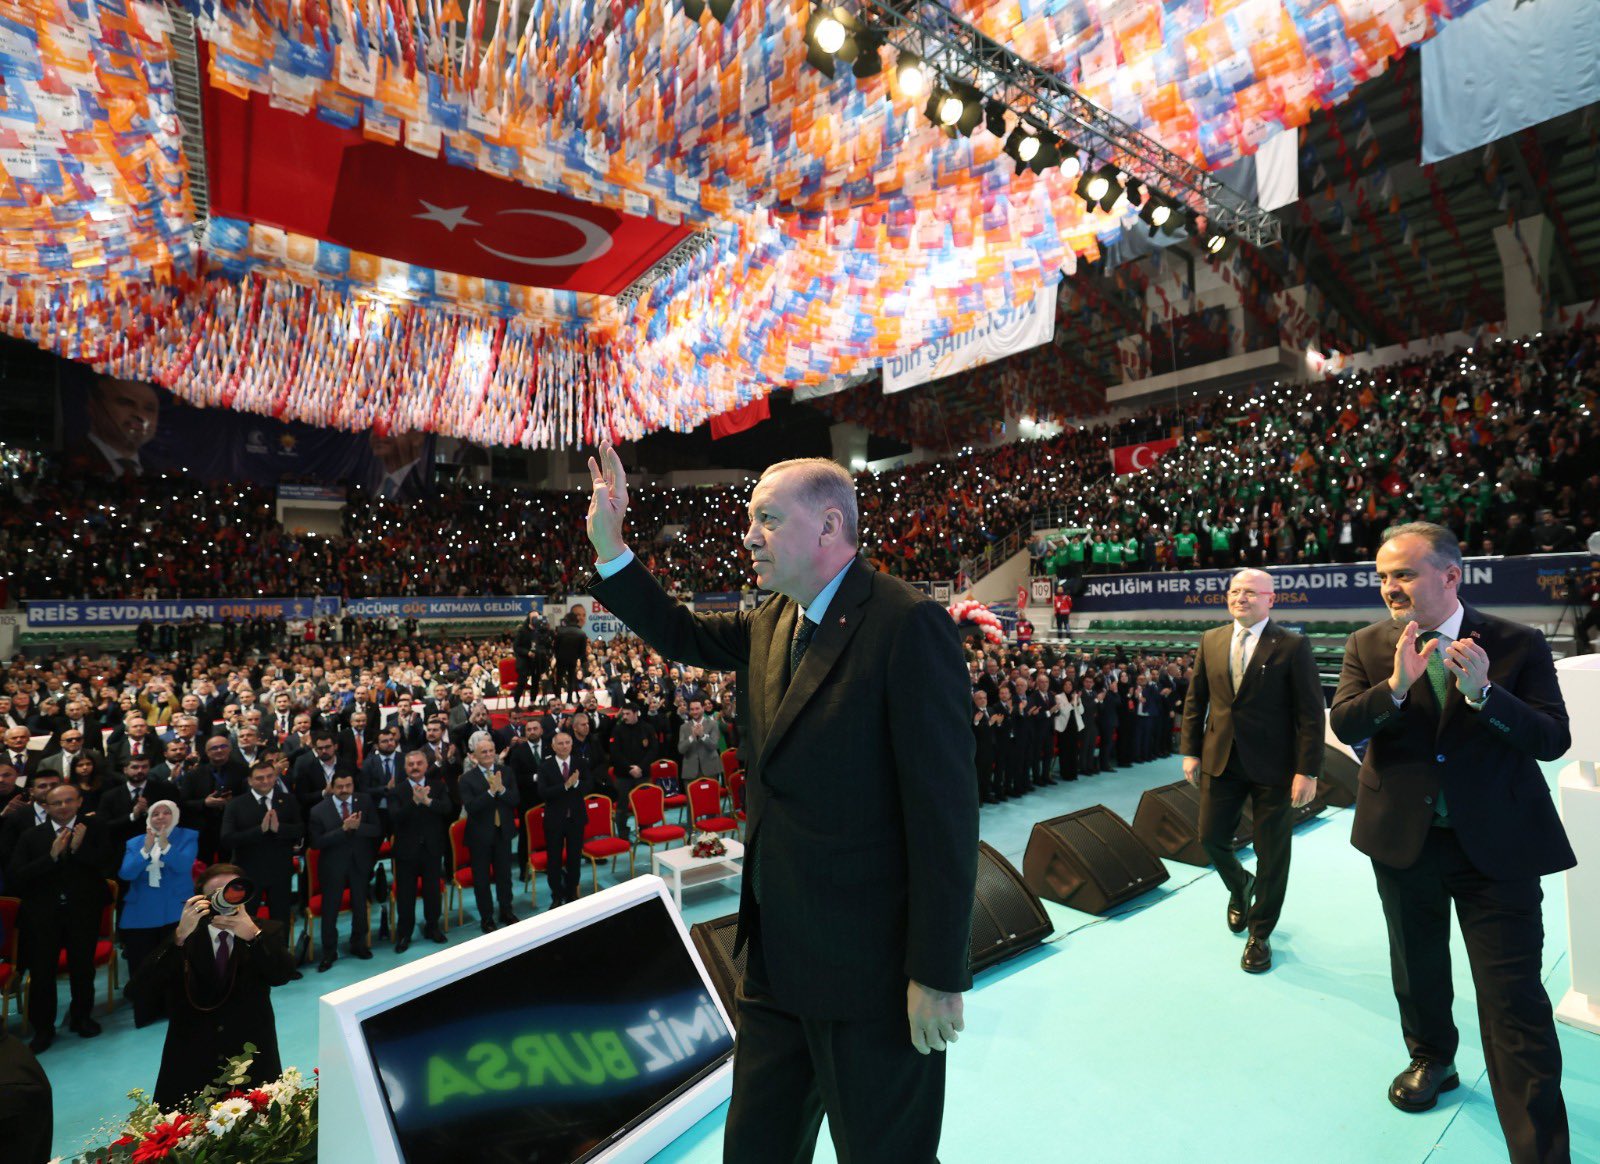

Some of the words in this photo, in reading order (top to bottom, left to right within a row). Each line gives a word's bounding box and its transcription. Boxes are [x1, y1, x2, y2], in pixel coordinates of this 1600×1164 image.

[1157, 577, 1191, 593] HER
[1195, 575, 1232, 593] ŞEY
[1274, 572, 1348, 590] EDADIR
[1354, 571, 1381, 587] SE
[1464, 564, 1493, 585] İN
[1034, 585, 1049, 596] 109
[1184, 594, 1201, 604] AK
[1204, 593, 1228, 605] GEN
[1275, 592, 1309, 603] URSA
[29, 604, 79, 622] REİS
[85, 605, 214, 620] SEVDALILARI
[347, 602, 400, 615] GÜCÜNE
[402, 602, 427, 615] GÜÇ
[430, 603, 481, 613] KATMAYA
[483, 602, 523, 612] GELDİK
